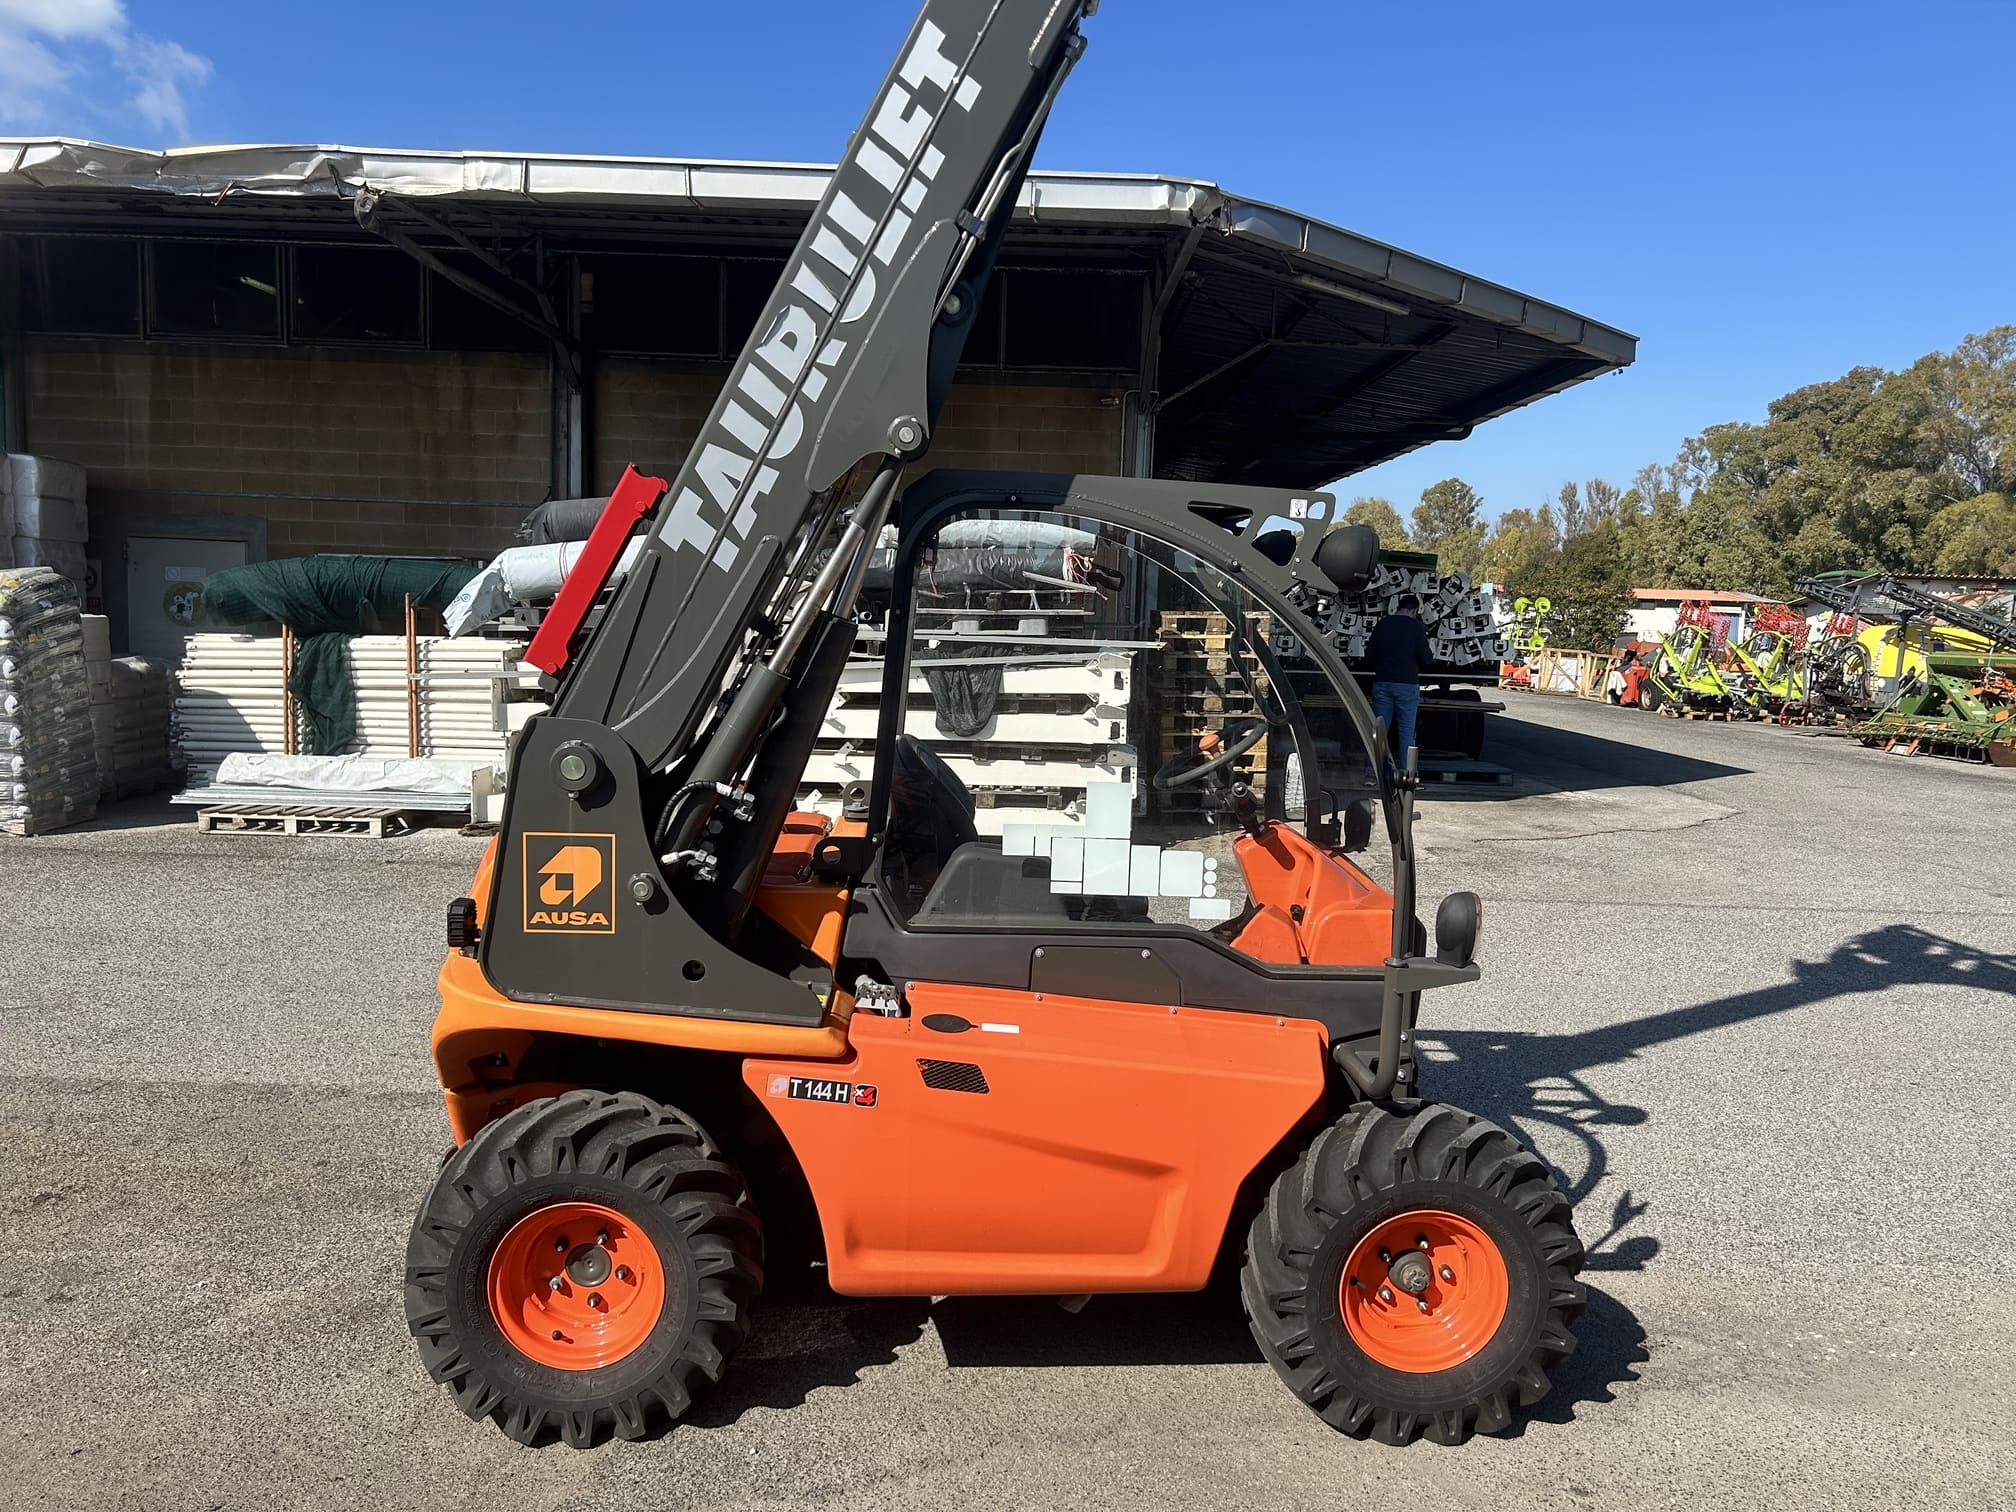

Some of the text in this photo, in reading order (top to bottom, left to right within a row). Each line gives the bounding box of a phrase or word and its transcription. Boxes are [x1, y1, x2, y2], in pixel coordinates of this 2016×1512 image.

[529, 911, 609, 926] AUSA
[790, 1079, 849, 1102] T 144 H
